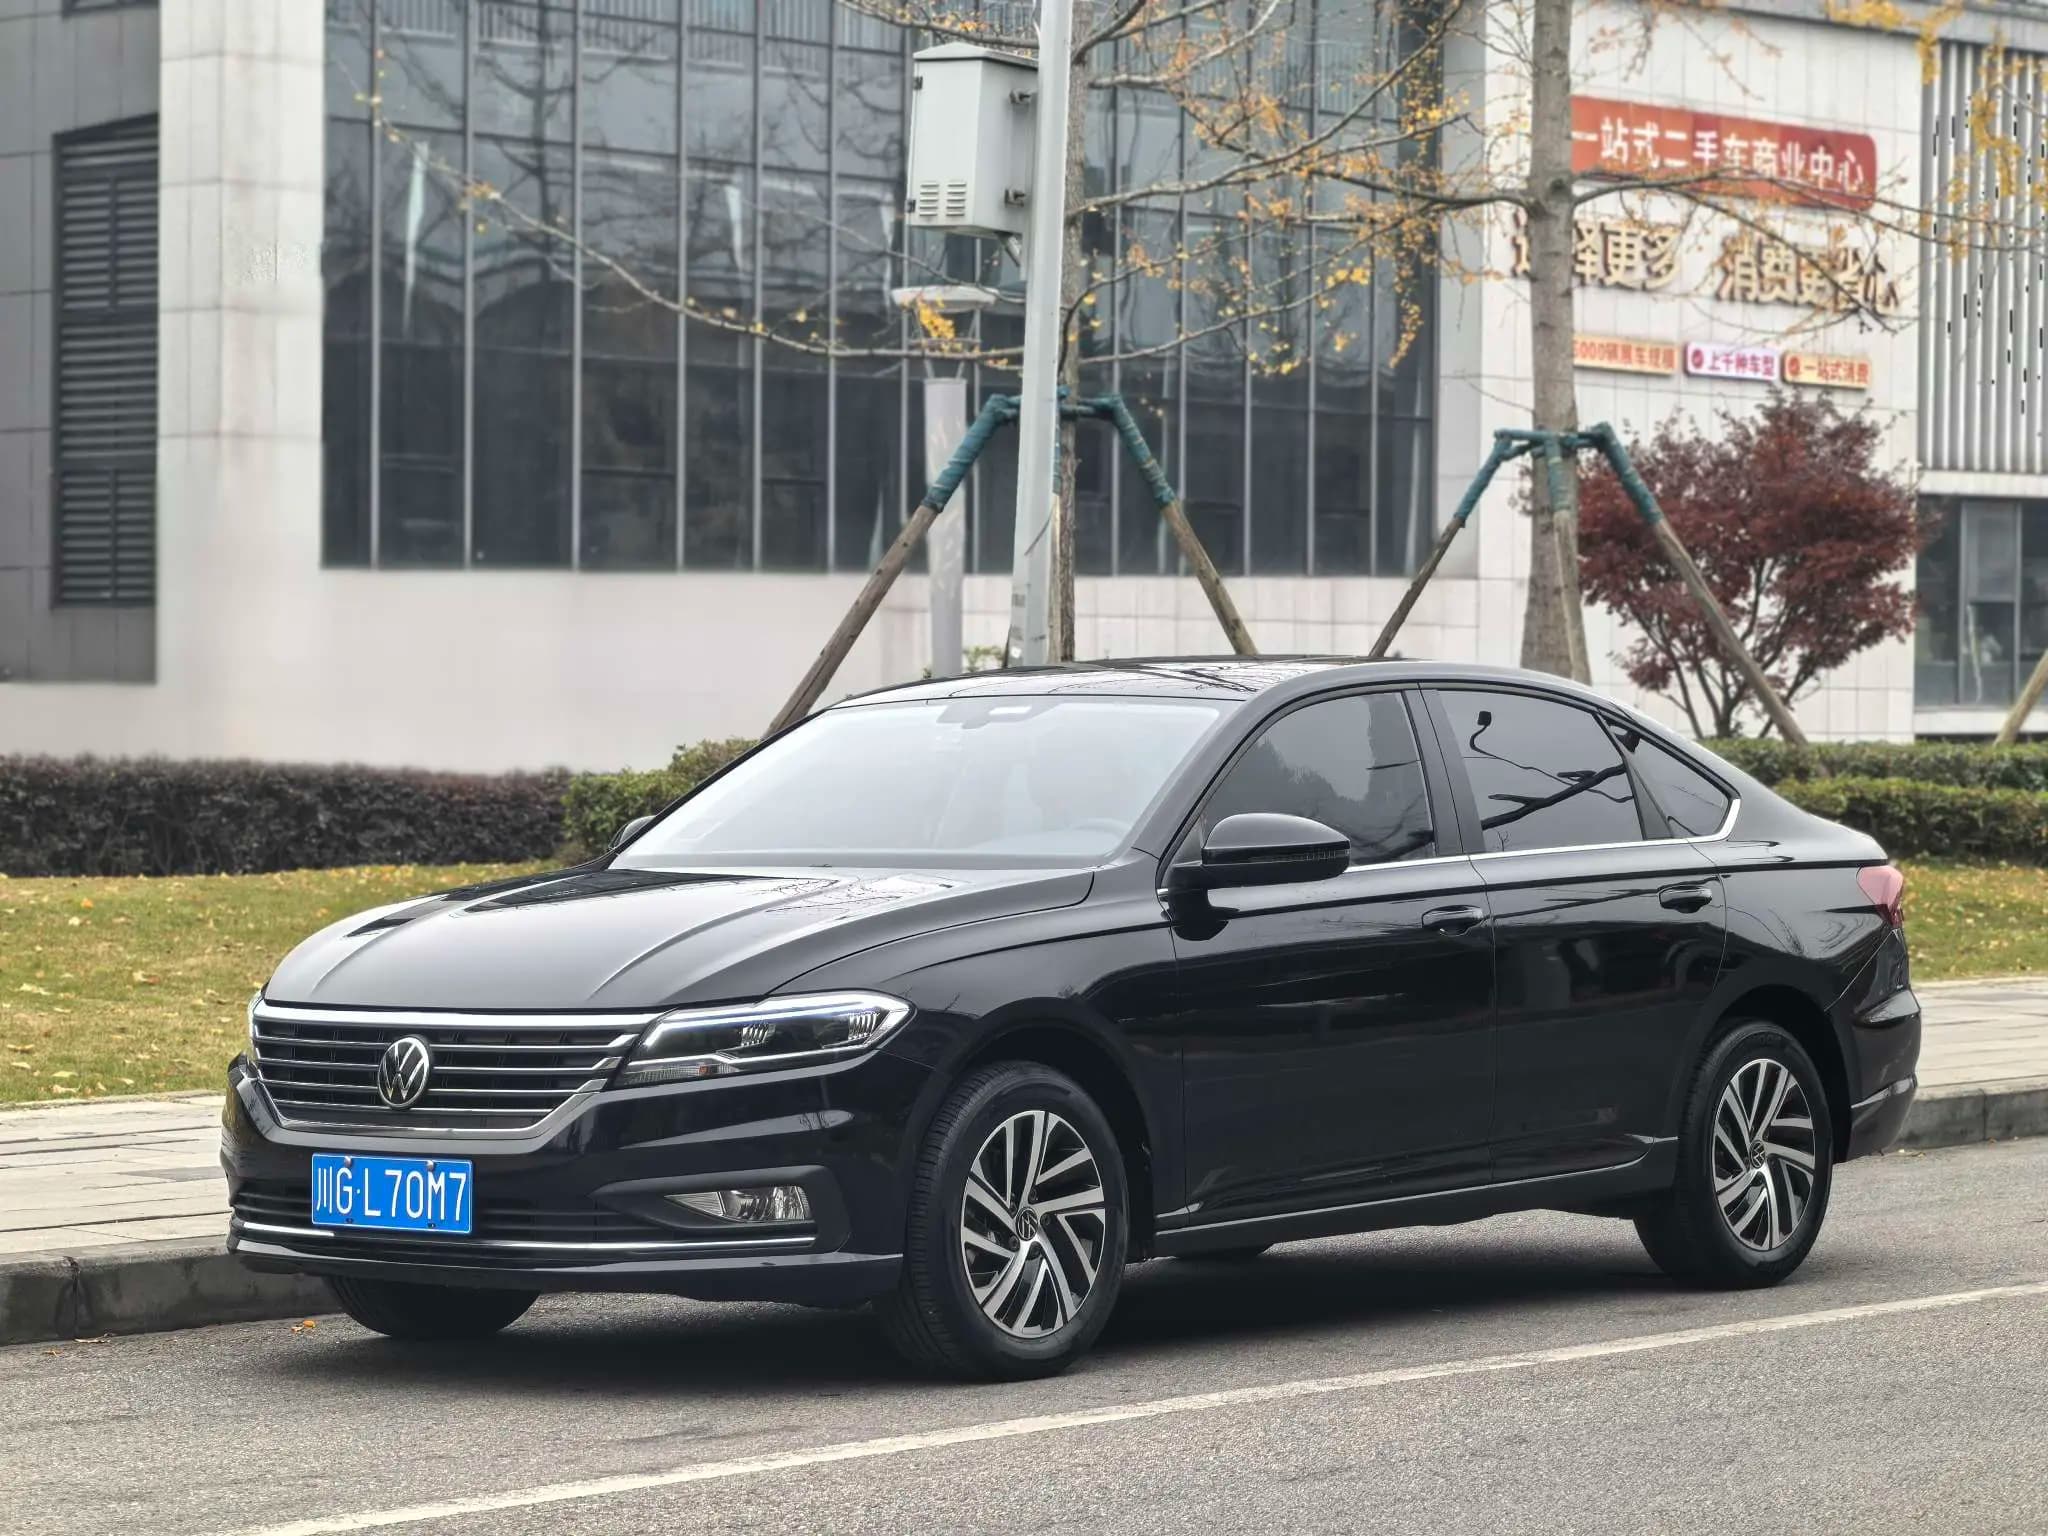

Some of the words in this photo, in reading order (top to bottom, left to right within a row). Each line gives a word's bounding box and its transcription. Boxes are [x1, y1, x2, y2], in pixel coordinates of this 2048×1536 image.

[1571, 115, 1865, 191] 一站式二手车商业中心
[1513, 207, 1682, 290] 择更多
[1708, 350, 1775, 376] 上千种车型
[1804, 357, 1869, 384] 一站式消费
